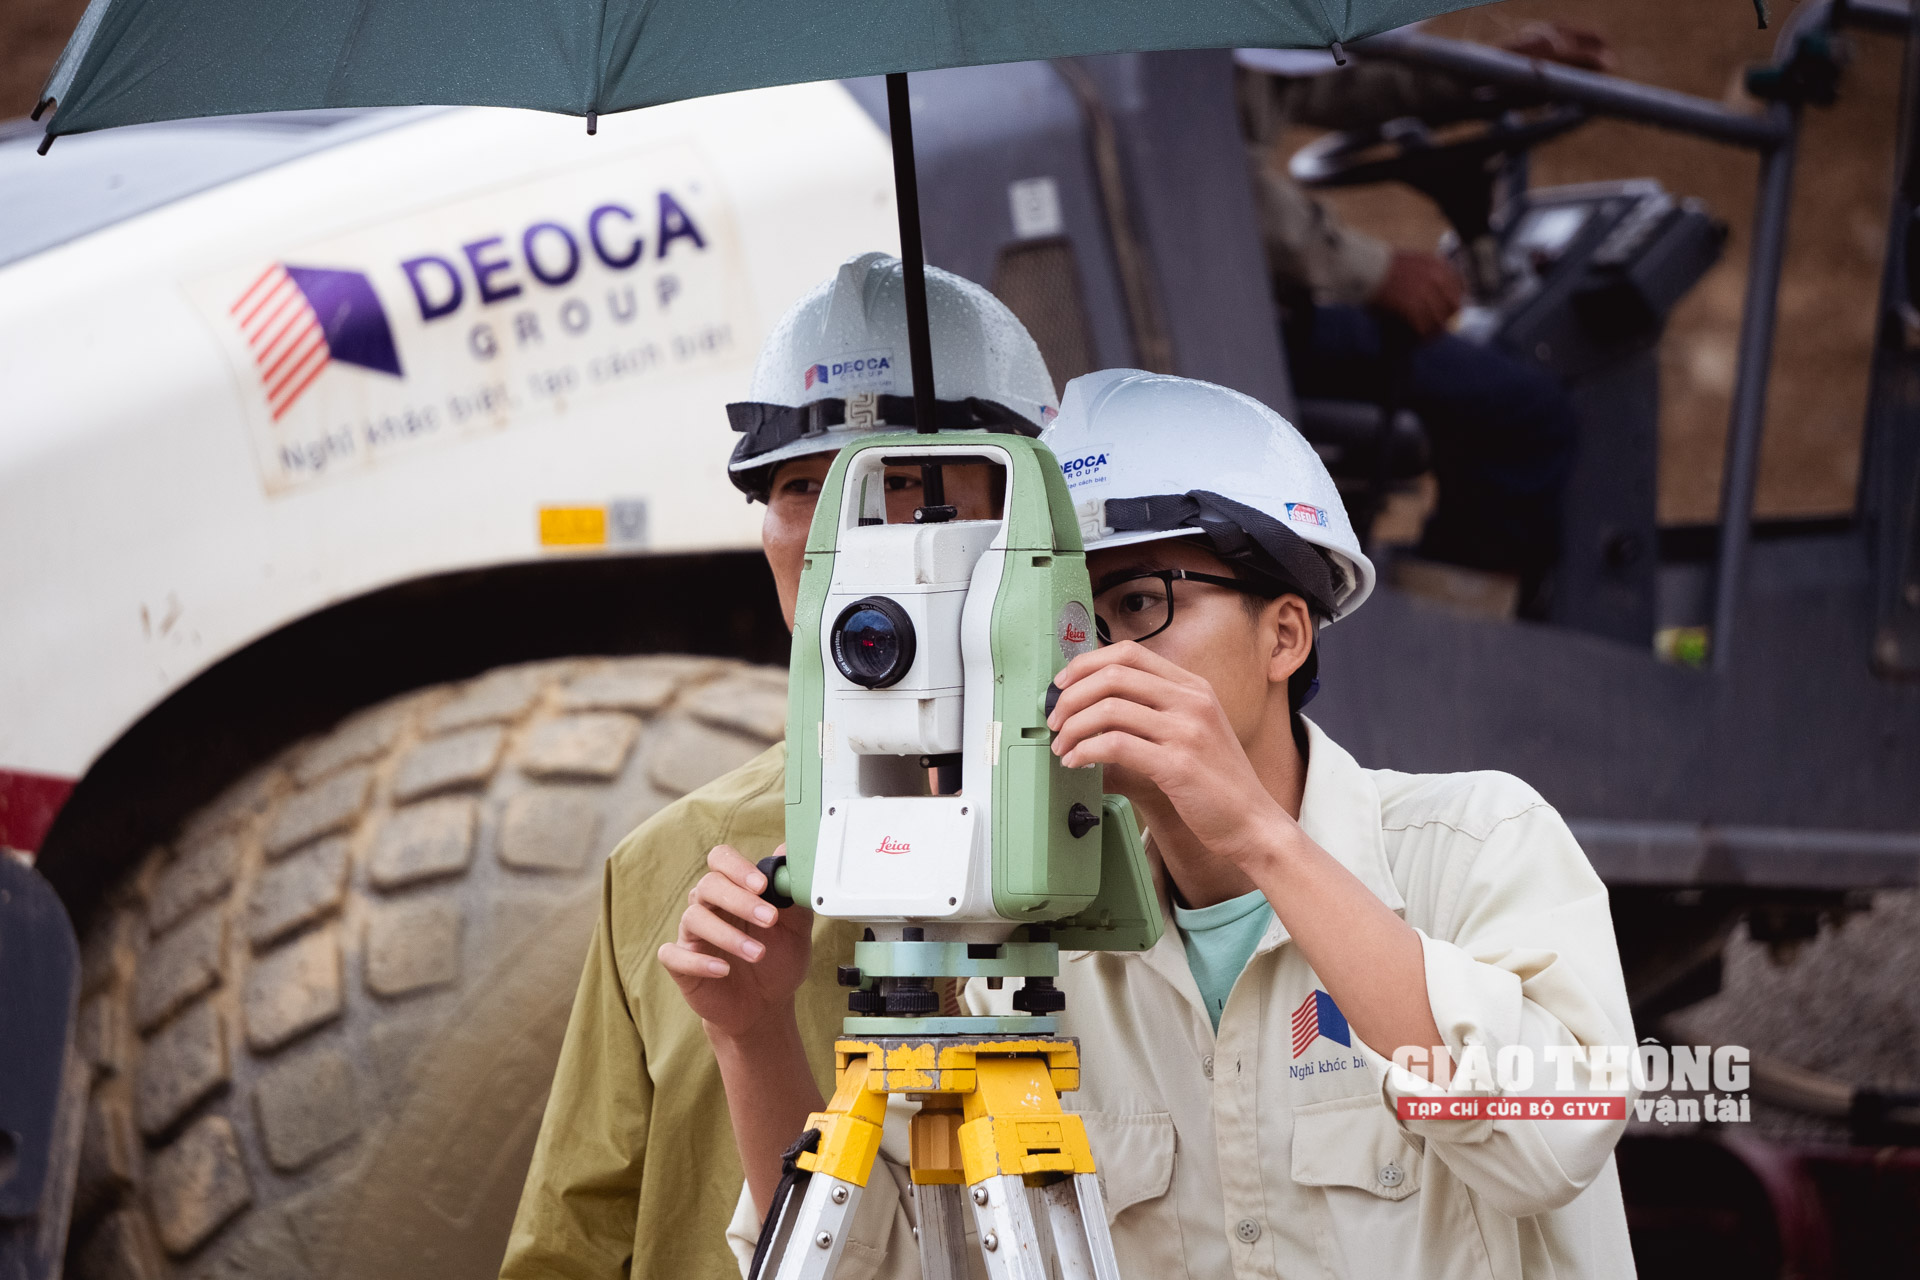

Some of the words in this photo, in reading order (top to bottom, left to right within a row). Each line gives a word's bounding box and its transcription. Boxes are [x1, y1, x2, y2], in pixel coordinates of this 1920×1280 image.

[400, 191, 707, 323] DEOCA
[467, 274, 682, 363] GROUP
[832, 357, 890, 376] DEOCA
[1060, 454, 1107, 474] EOCA
[1067, 467, 1100, 480] ROUP
[1063, 623, 1086, 643] Leica
[875, 836, 911, 855] Leica
